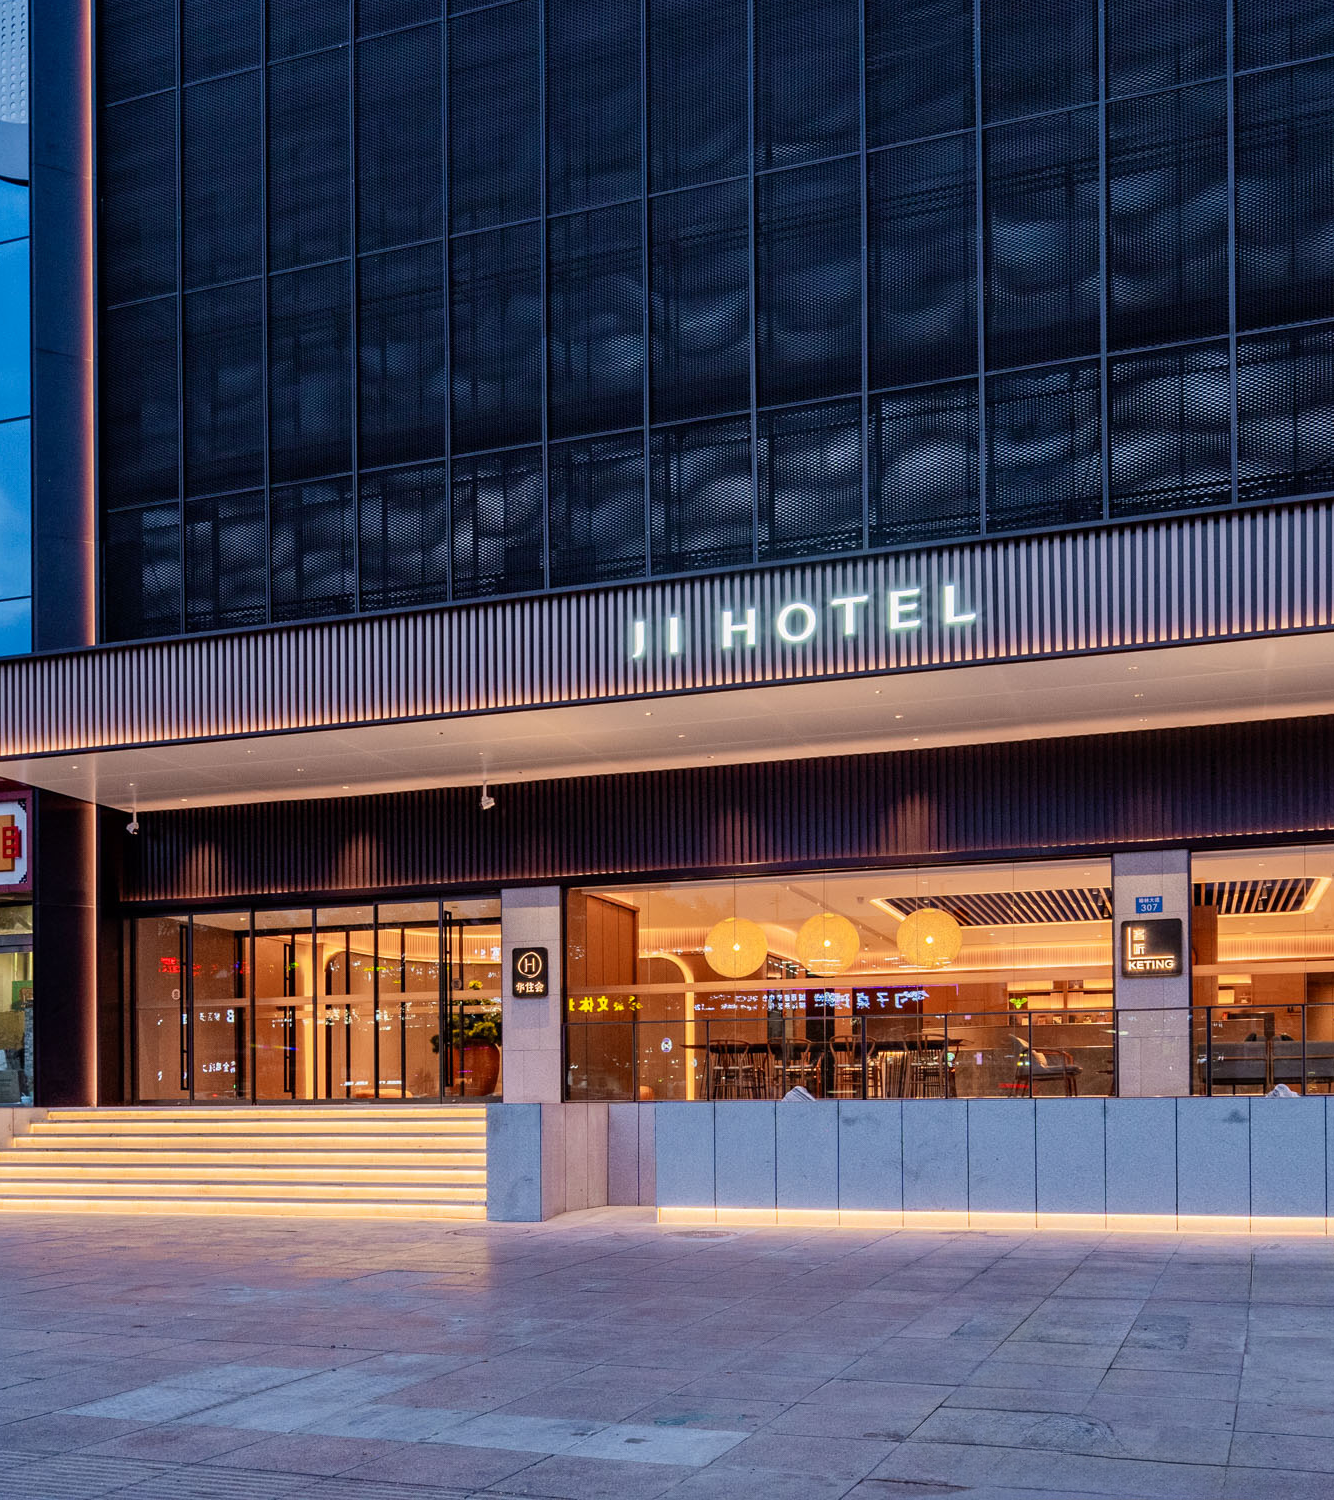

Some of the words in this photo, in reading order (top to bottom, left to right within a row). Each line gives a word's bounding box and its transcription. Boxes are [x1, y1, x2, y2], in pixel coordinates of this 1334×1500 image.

[632, 616, 679, 658] JI
[722, 585, 976, 650] HOTEL
[1141, 904, 1158, 912] 307
[1128, 960, 1175, 970] KETING
[515, 981, 544, 994] 华住会
